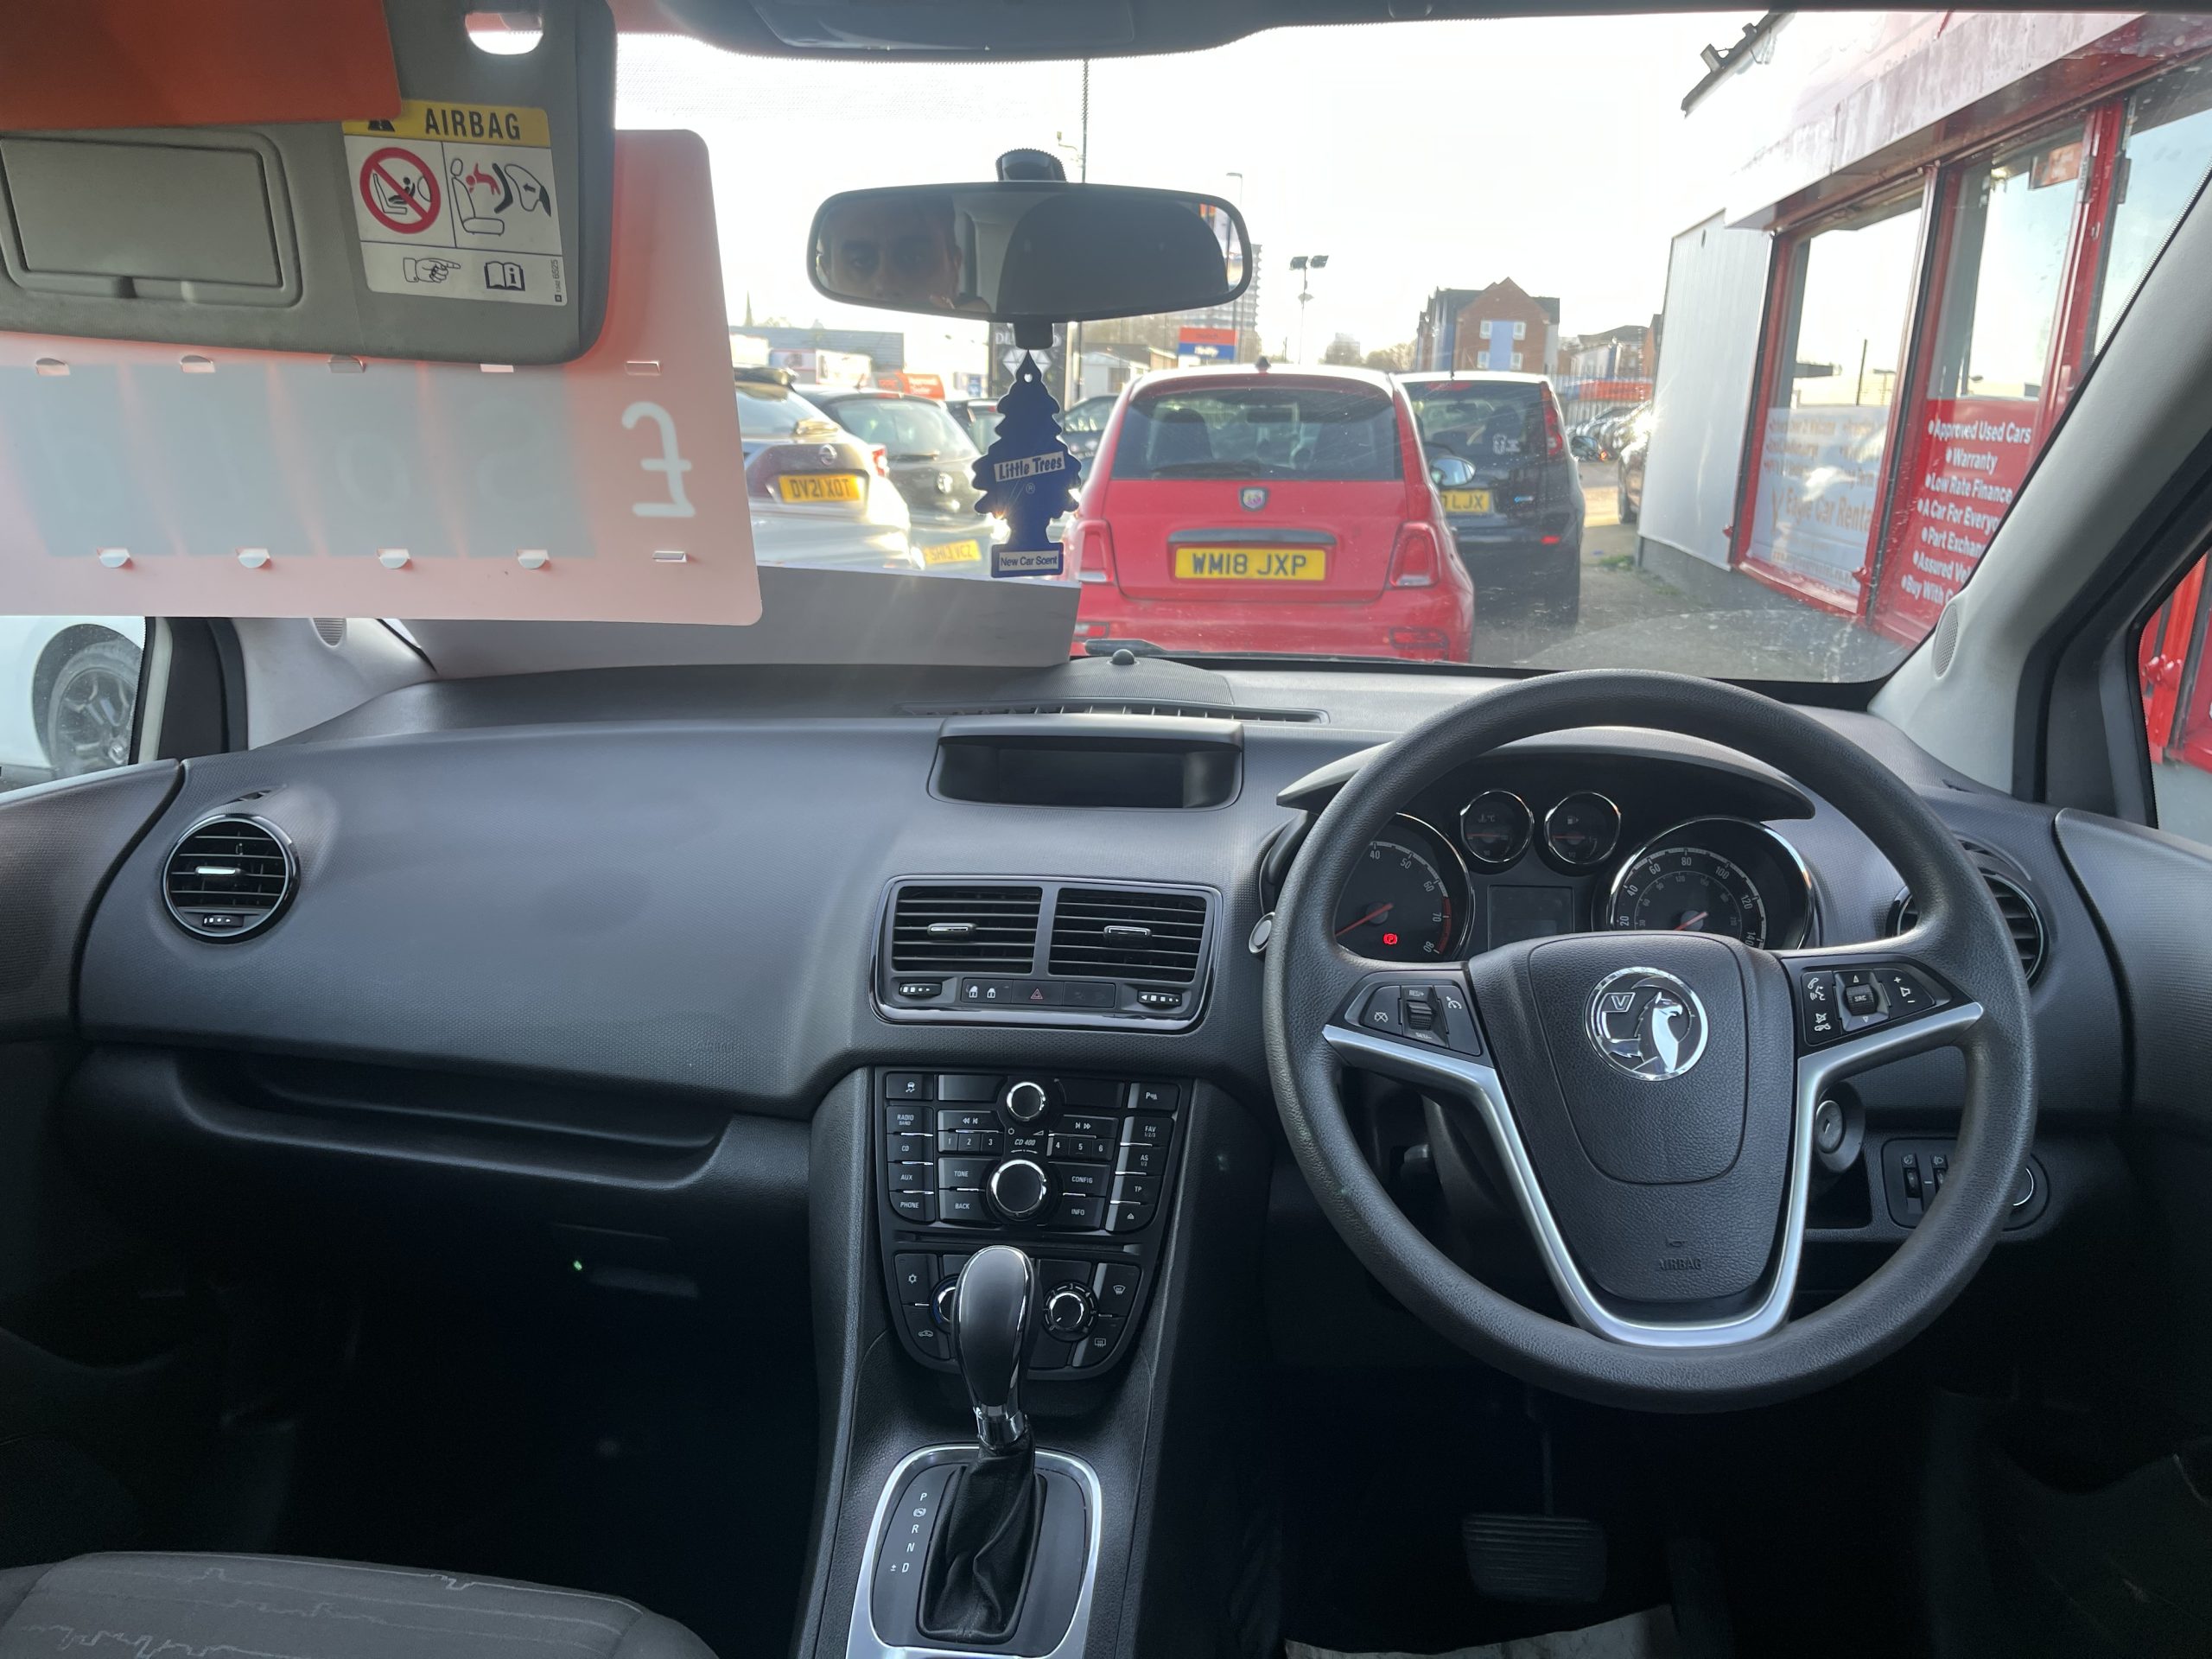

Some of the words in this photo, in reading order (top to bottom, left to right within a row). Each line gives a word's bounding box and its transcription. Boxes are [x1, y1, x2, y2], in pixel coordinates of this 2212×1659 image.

[424, 107, 522, 141] AIRBAG
[1934, 418, 1979, 442] Approved
[1978, 419, 2005, 442] Used
[2005, 421, 2032, 445] Cars
[998, 461, 1031, 481] Little
[1032, 455, 1063, 474] Trees
[1952, 447, 1998, 476] Warranty
[1930, 472, 1949, 493] Low
[1948, 475, 1971, 498] Rate
[1971, 478, 2013, 505] Finance
[1922, 498, 1930, 518] A
[1930, 499, 1947, 520] Car
[1947, 502, 1964, 524] For
[1963, 505, 2003, 537] Everyo
[1928, 525, 1947, 550] Part
[1001, 556, 1018, 568] New
[1020, 556, 1034, 567] Car
[1035, 555, 1058, 567] Scent
[1192, 552, 1249, 575] WM18
[1256, 554, 1307, 576] JXP
[1918, 550, 1954, 581] Assured
[1906, 574, 1923, 601] Buy
[1922, 580, 1944, 607] With
[1370, 849, 1381, 860] 40
[1681, 856, 1692, 866] 80
[1400, 857, 1412, 869] 50
[1649, 862, 1661, 875] 60
[1715, 865, 1730, 880] 100
[1423, 880, 1434, 892] 60
[1626, 884, 1639, 897] 40
[1740, 894, 1753, 910] 120
[1432, 912, 1442, 923] 70
[1619, 915, 1630, 927] 20
[1422, 940, 1434, 953] 80
[1071, 1175, 1094, 1184] CONFIG
[1659, 1257, 1702, 1271] AIRBAG
[919, 1492, 928, 1502] P
[911, 1524, 919, 1534] R
[906, 1542, 915, 1553] N
[901, 1563, 910, 1573] D
